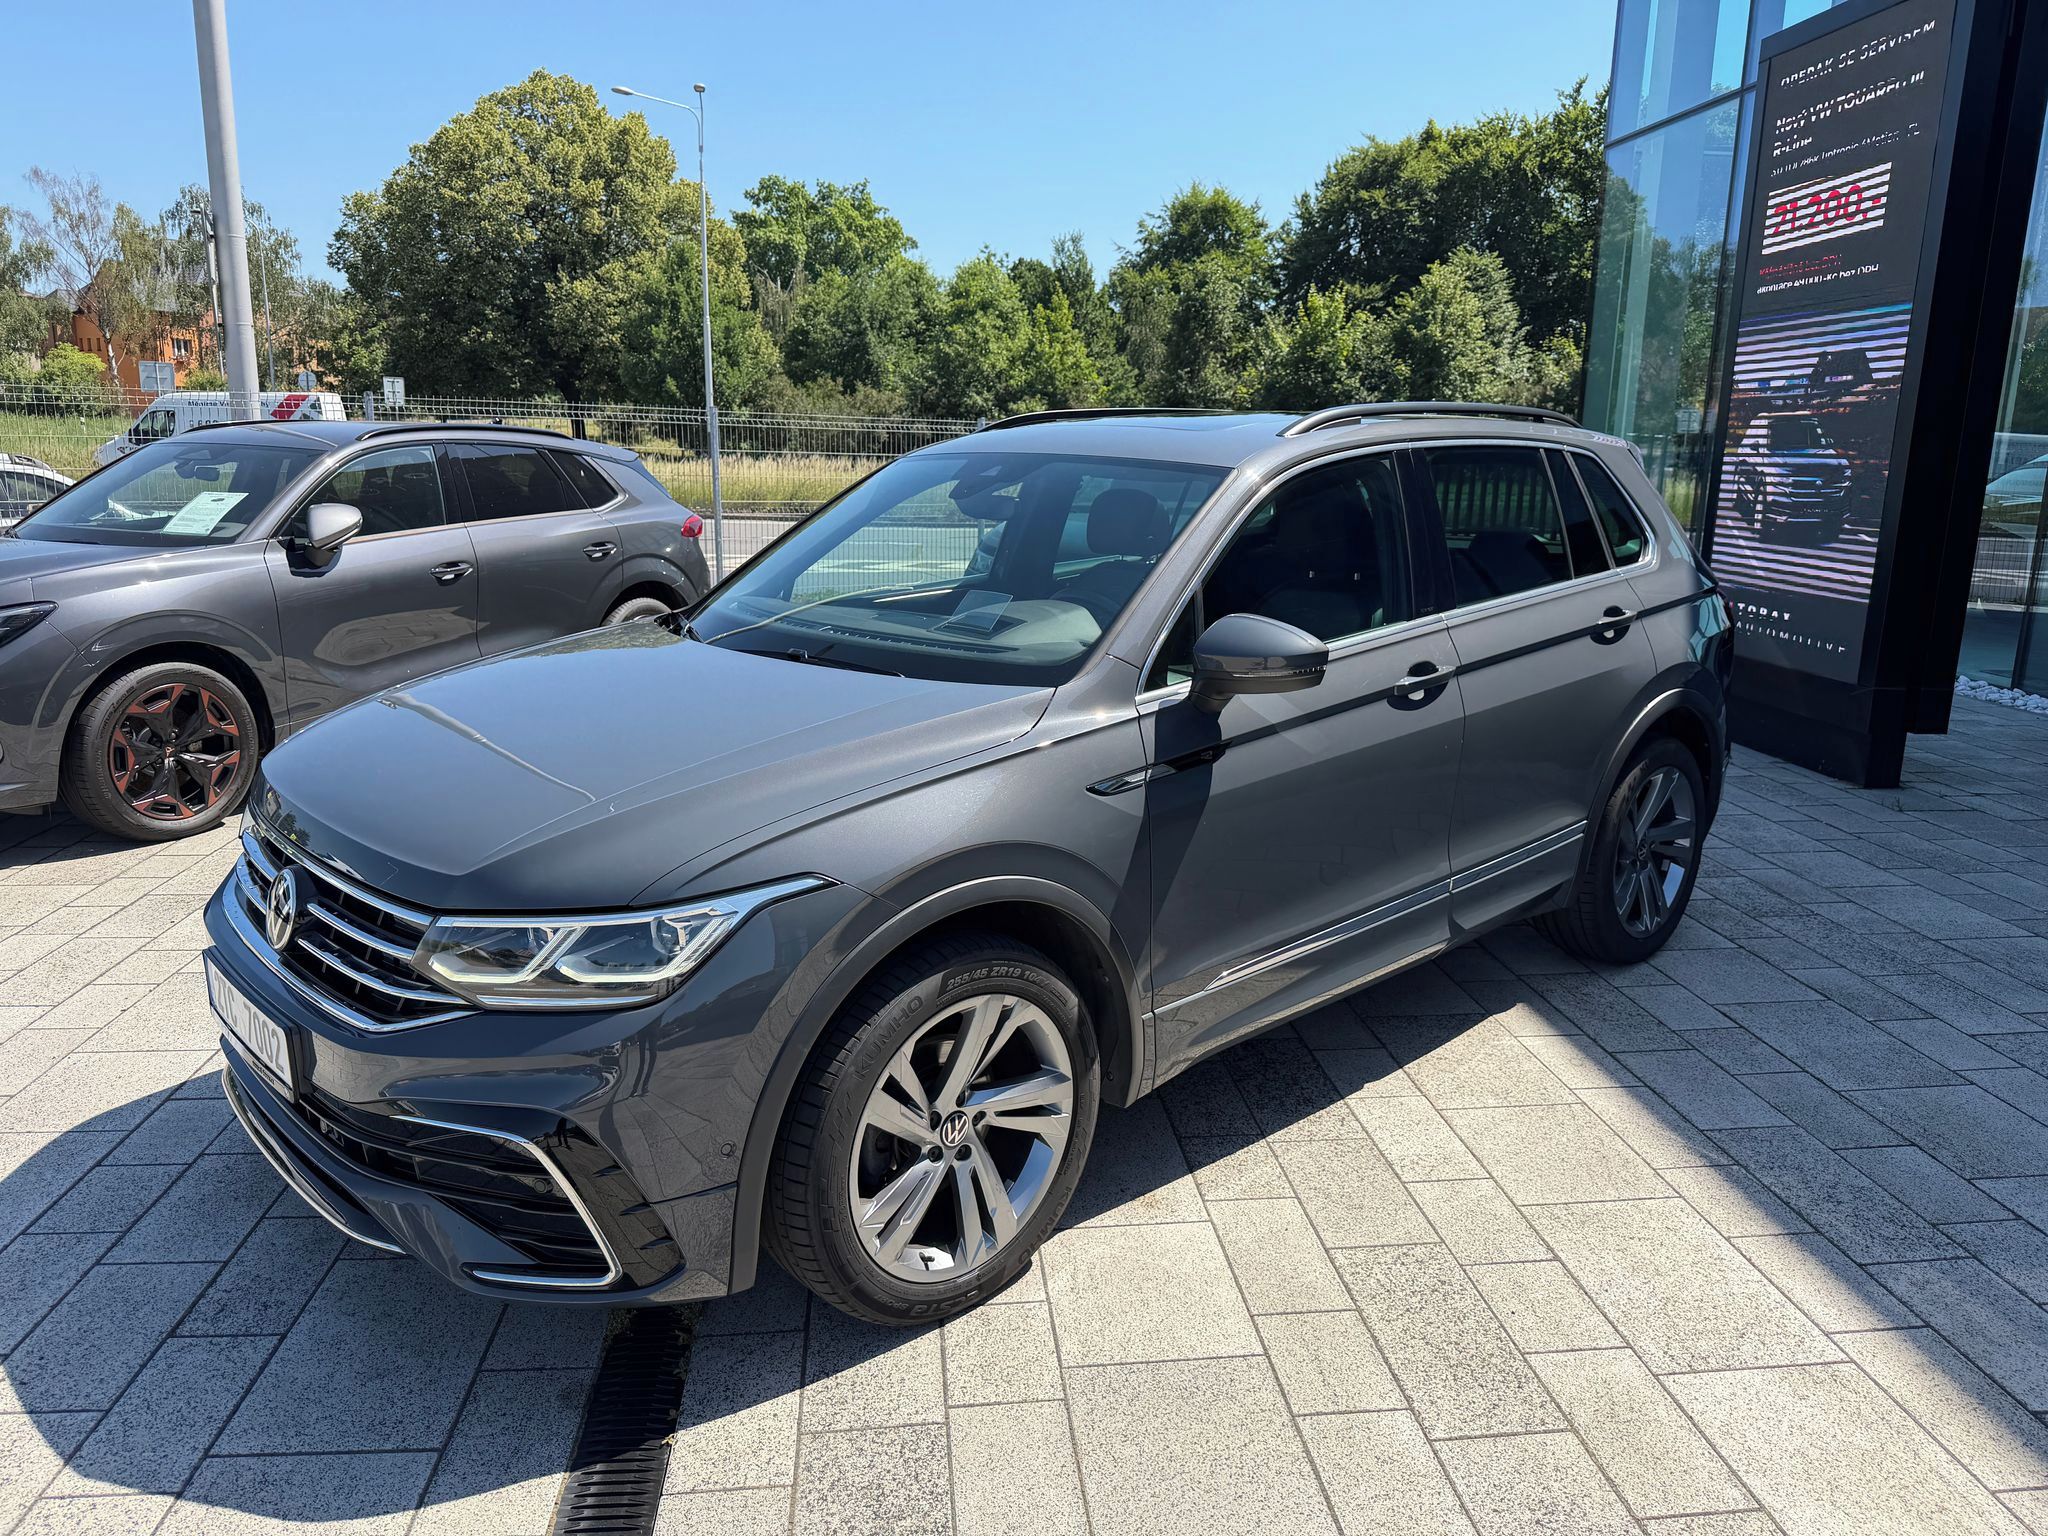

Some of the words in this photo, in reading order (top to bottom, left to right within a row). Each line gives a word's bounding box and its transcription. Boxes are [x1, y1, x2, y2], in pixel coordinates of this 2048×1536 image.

[946, 967, 989, 992] 255/45
[992, 966, 1021, 979] ZR19
[242, 1000, 287, 1077] 7002
[853, 995, 925, 1082] KUMHO
